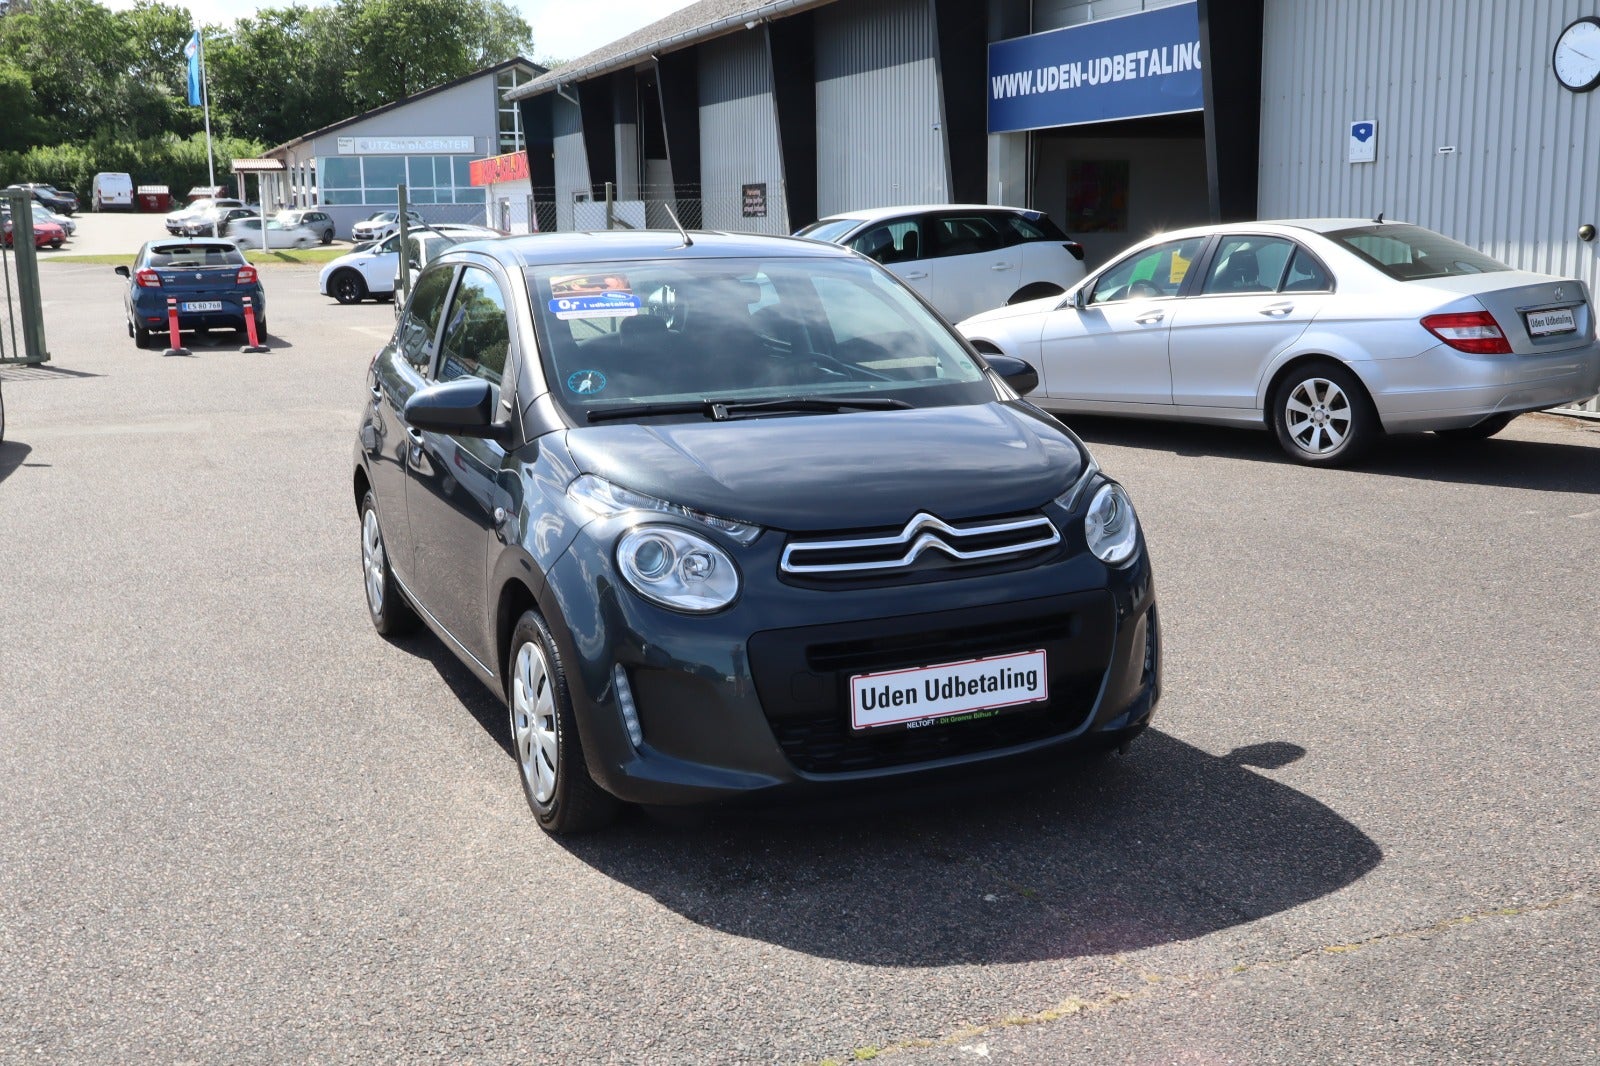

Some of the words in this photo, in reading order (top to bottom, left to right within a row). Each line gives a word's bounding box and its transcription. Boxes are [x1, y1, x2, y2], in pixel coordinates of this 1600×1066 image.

[1530, 318, 1545, 328] Uden
[1545, 315, 1573, 326] Udbetaling
[861, 685, 918, 711] Uden
[924, 667, 1038, 702] Udbetaling
[906, 718, 935, 729] NELTOFT
[940, 717, 949, 725] Dit
